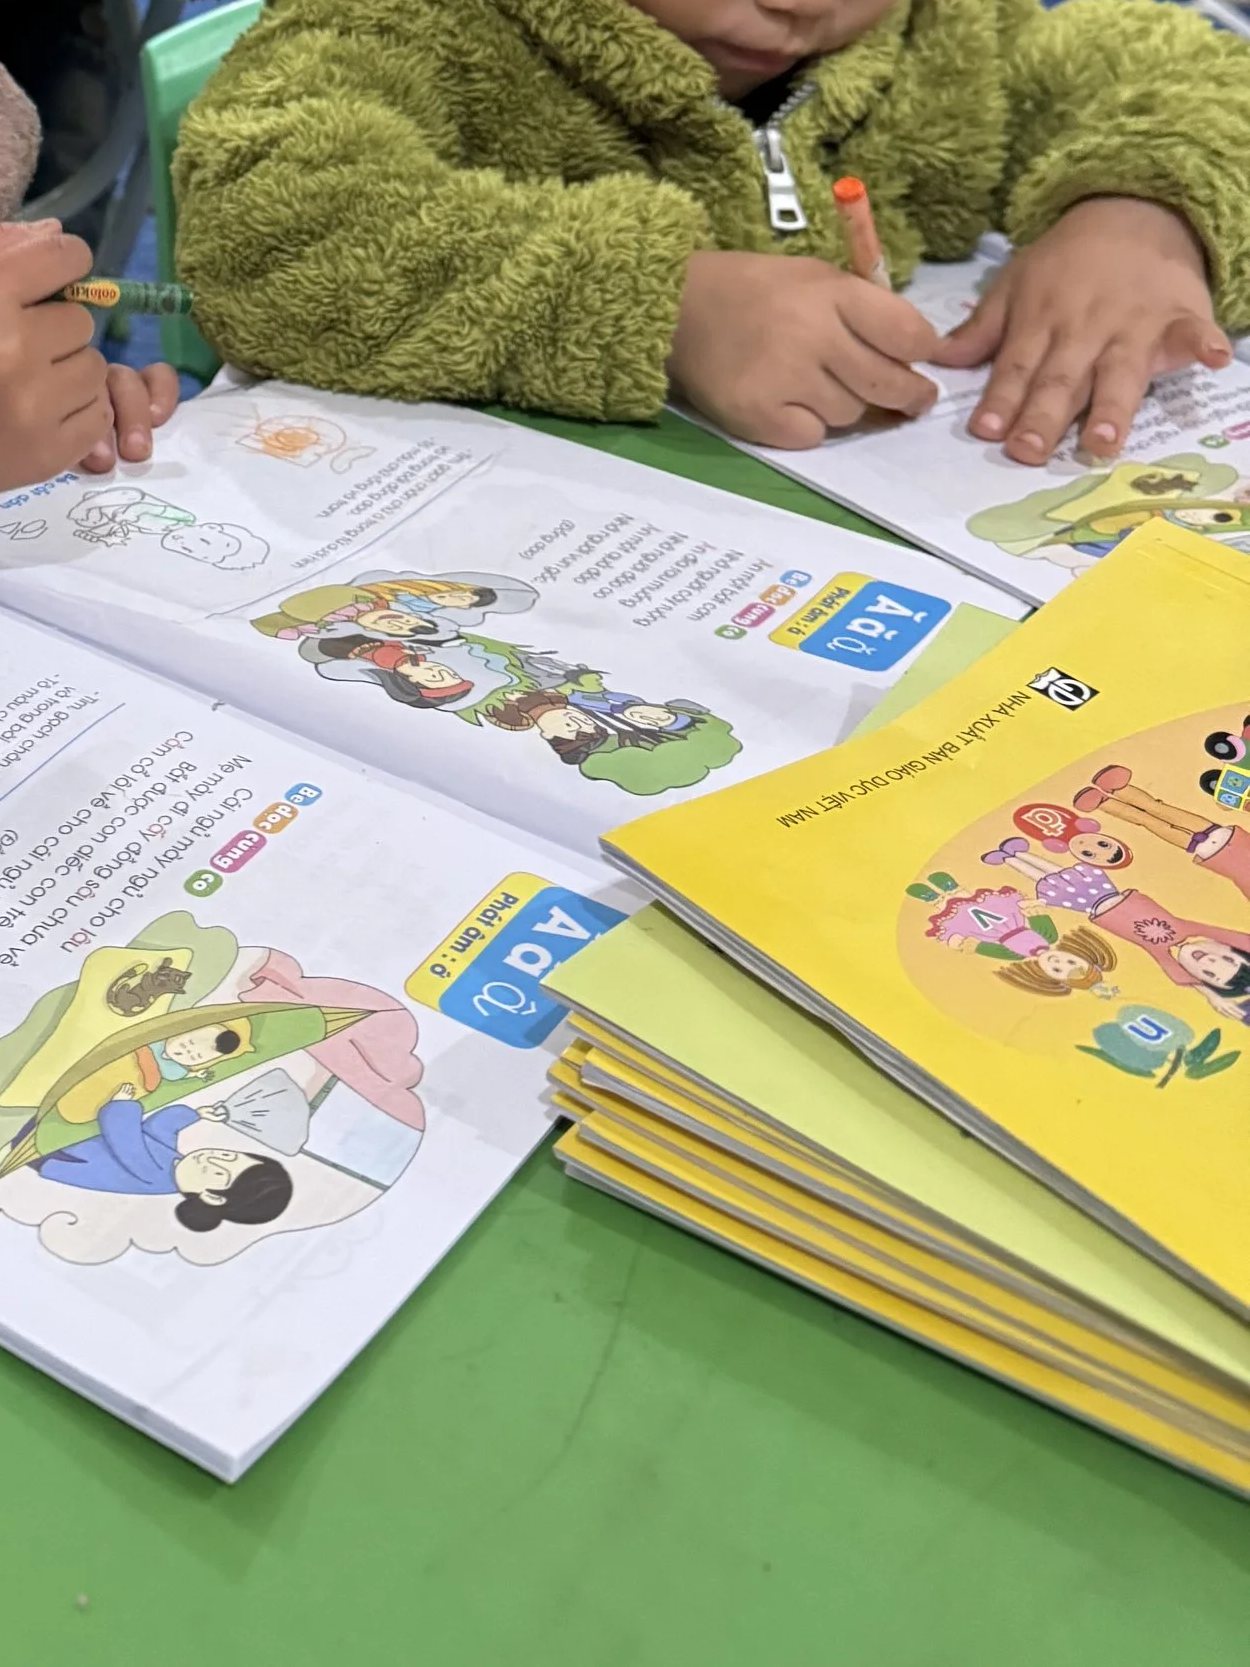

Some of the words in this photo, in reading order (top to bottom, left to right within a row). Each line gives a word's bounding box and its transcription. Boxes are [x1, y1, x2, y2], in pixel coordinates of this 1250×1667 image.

[865, 594, 927, 622] Ă
[846, 617, 897, 639] ă
[5, 687, 39, 710] màu
[54, 686, 75, 698] và
[991, 690, 1031, 717] NHÀ
[18, 697, 60, 723] trong
[32, 710, 69, 738] gạch
[956, 713, 999, 745] XUẤT
[150, 730, 193, 756] Cầm
[921, 741, 960, 764] BẢN
[130, 757, 154, 777] cổ
[164, 761, 197, 783] Bắt
[217, 754, 252, 773] Mẹ
[885, 760, 926, 780] GIÁO
[109, 773, 137, 794] lôi
[184, 772, 224, 801] mày
[849, 775, 889, 798] DỤC
[90, 791, 116, 809] về
[124, 782, 173, 815] được
[168, 800, 189, 816] đi
[218, 788, 253, 812] Cái
[815, 791, 855, 811] VIỆT
[57, 808, 91, 834] cho
[90, 816, 126, 843] con
[138, 815, 172, 842] cấy
[189, 809, 224, 837] ngủ
[776, 806, 819, 827] NAM
[27, 836, 59, 861] cái
[54, 844, 93, 875] diếc
[93, 841, 141, 879] đồng
[153, 835, 194, 868] mày
[18, 877, 56, 905] con
[65, 879, 99, 906] sâu
[121, 867, 159, 898] ngủ
[89, 897, 125, 927] cho
[475, 891, 519, 928] Phát
[19, 907, 68, 945] chưa
[59, 927, 96, 952] lâu
[449, 926, 484, 953] âm
[429, 962, 450, 978] ớ
[473, 982, 536, 1016] â
